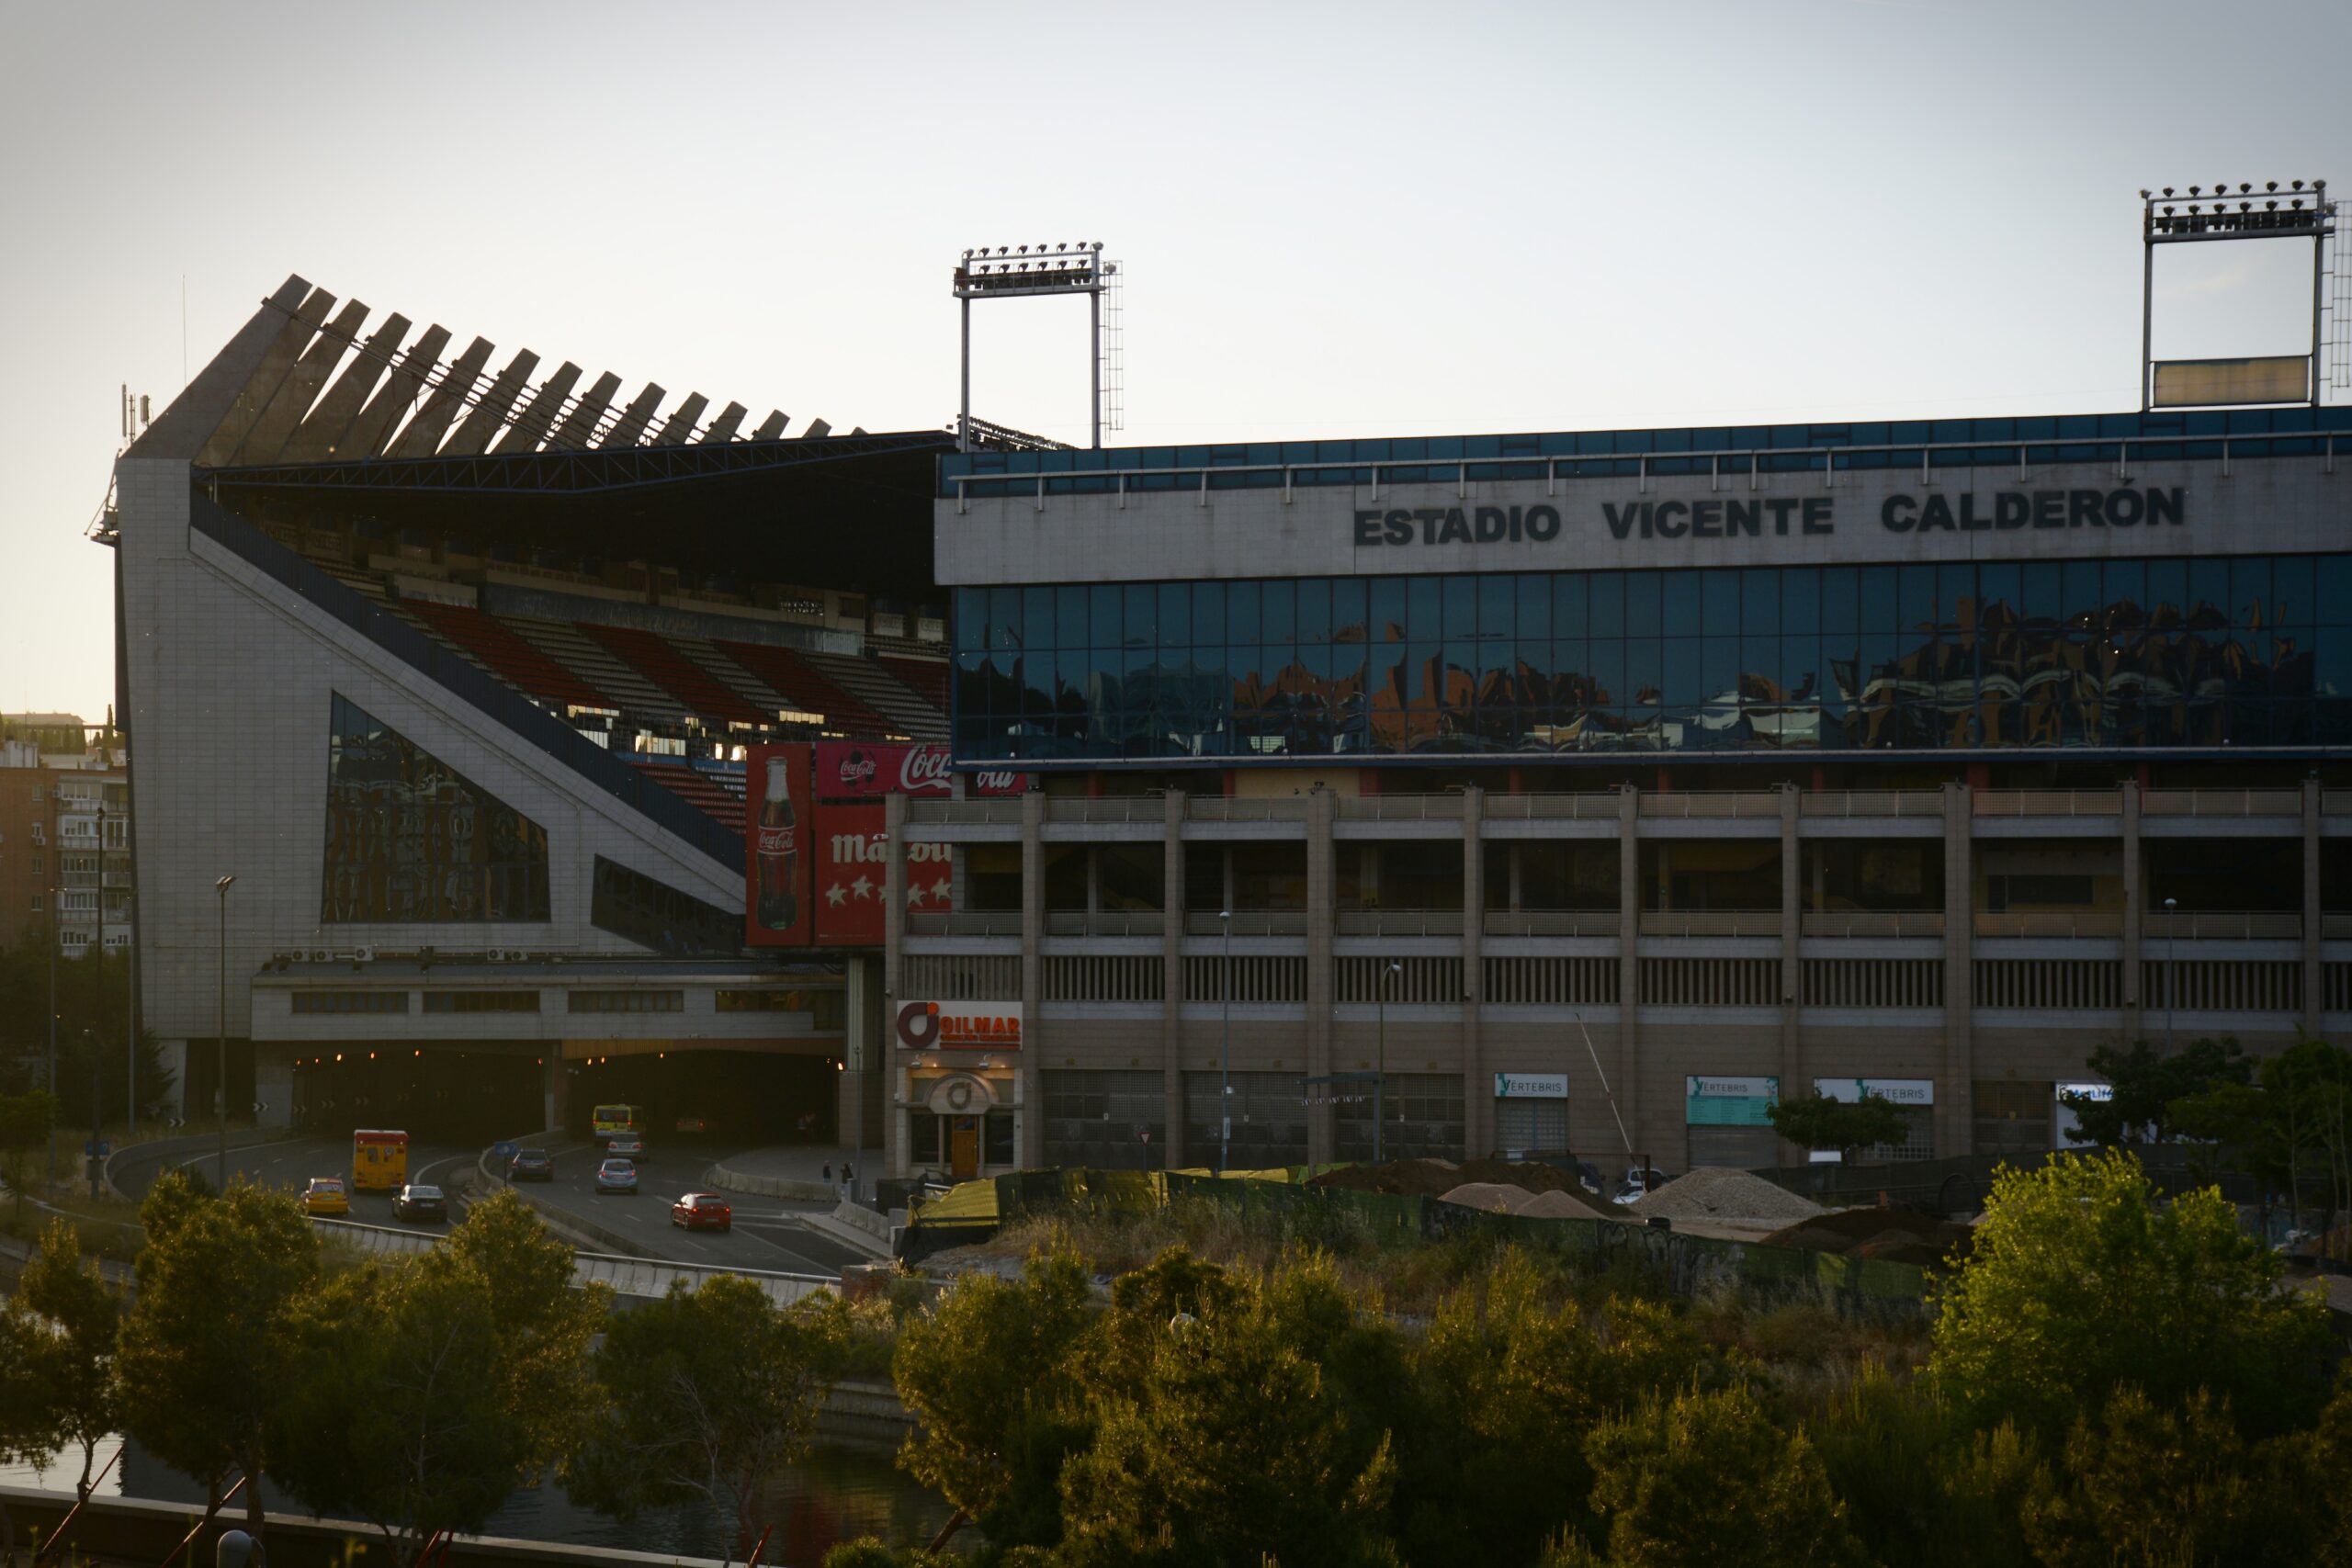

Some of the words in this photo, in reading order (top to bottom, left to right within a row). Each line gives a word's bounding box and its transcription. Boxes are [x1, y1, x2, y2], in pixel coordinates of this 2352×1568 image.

[1354, 503, 1560, 547] ESTADIO
[1601, 497, 1833, 540] VICENTE
[1882, 478, 2185, 533] CALDERÓN
[831, 833, 952, 863] Maou
